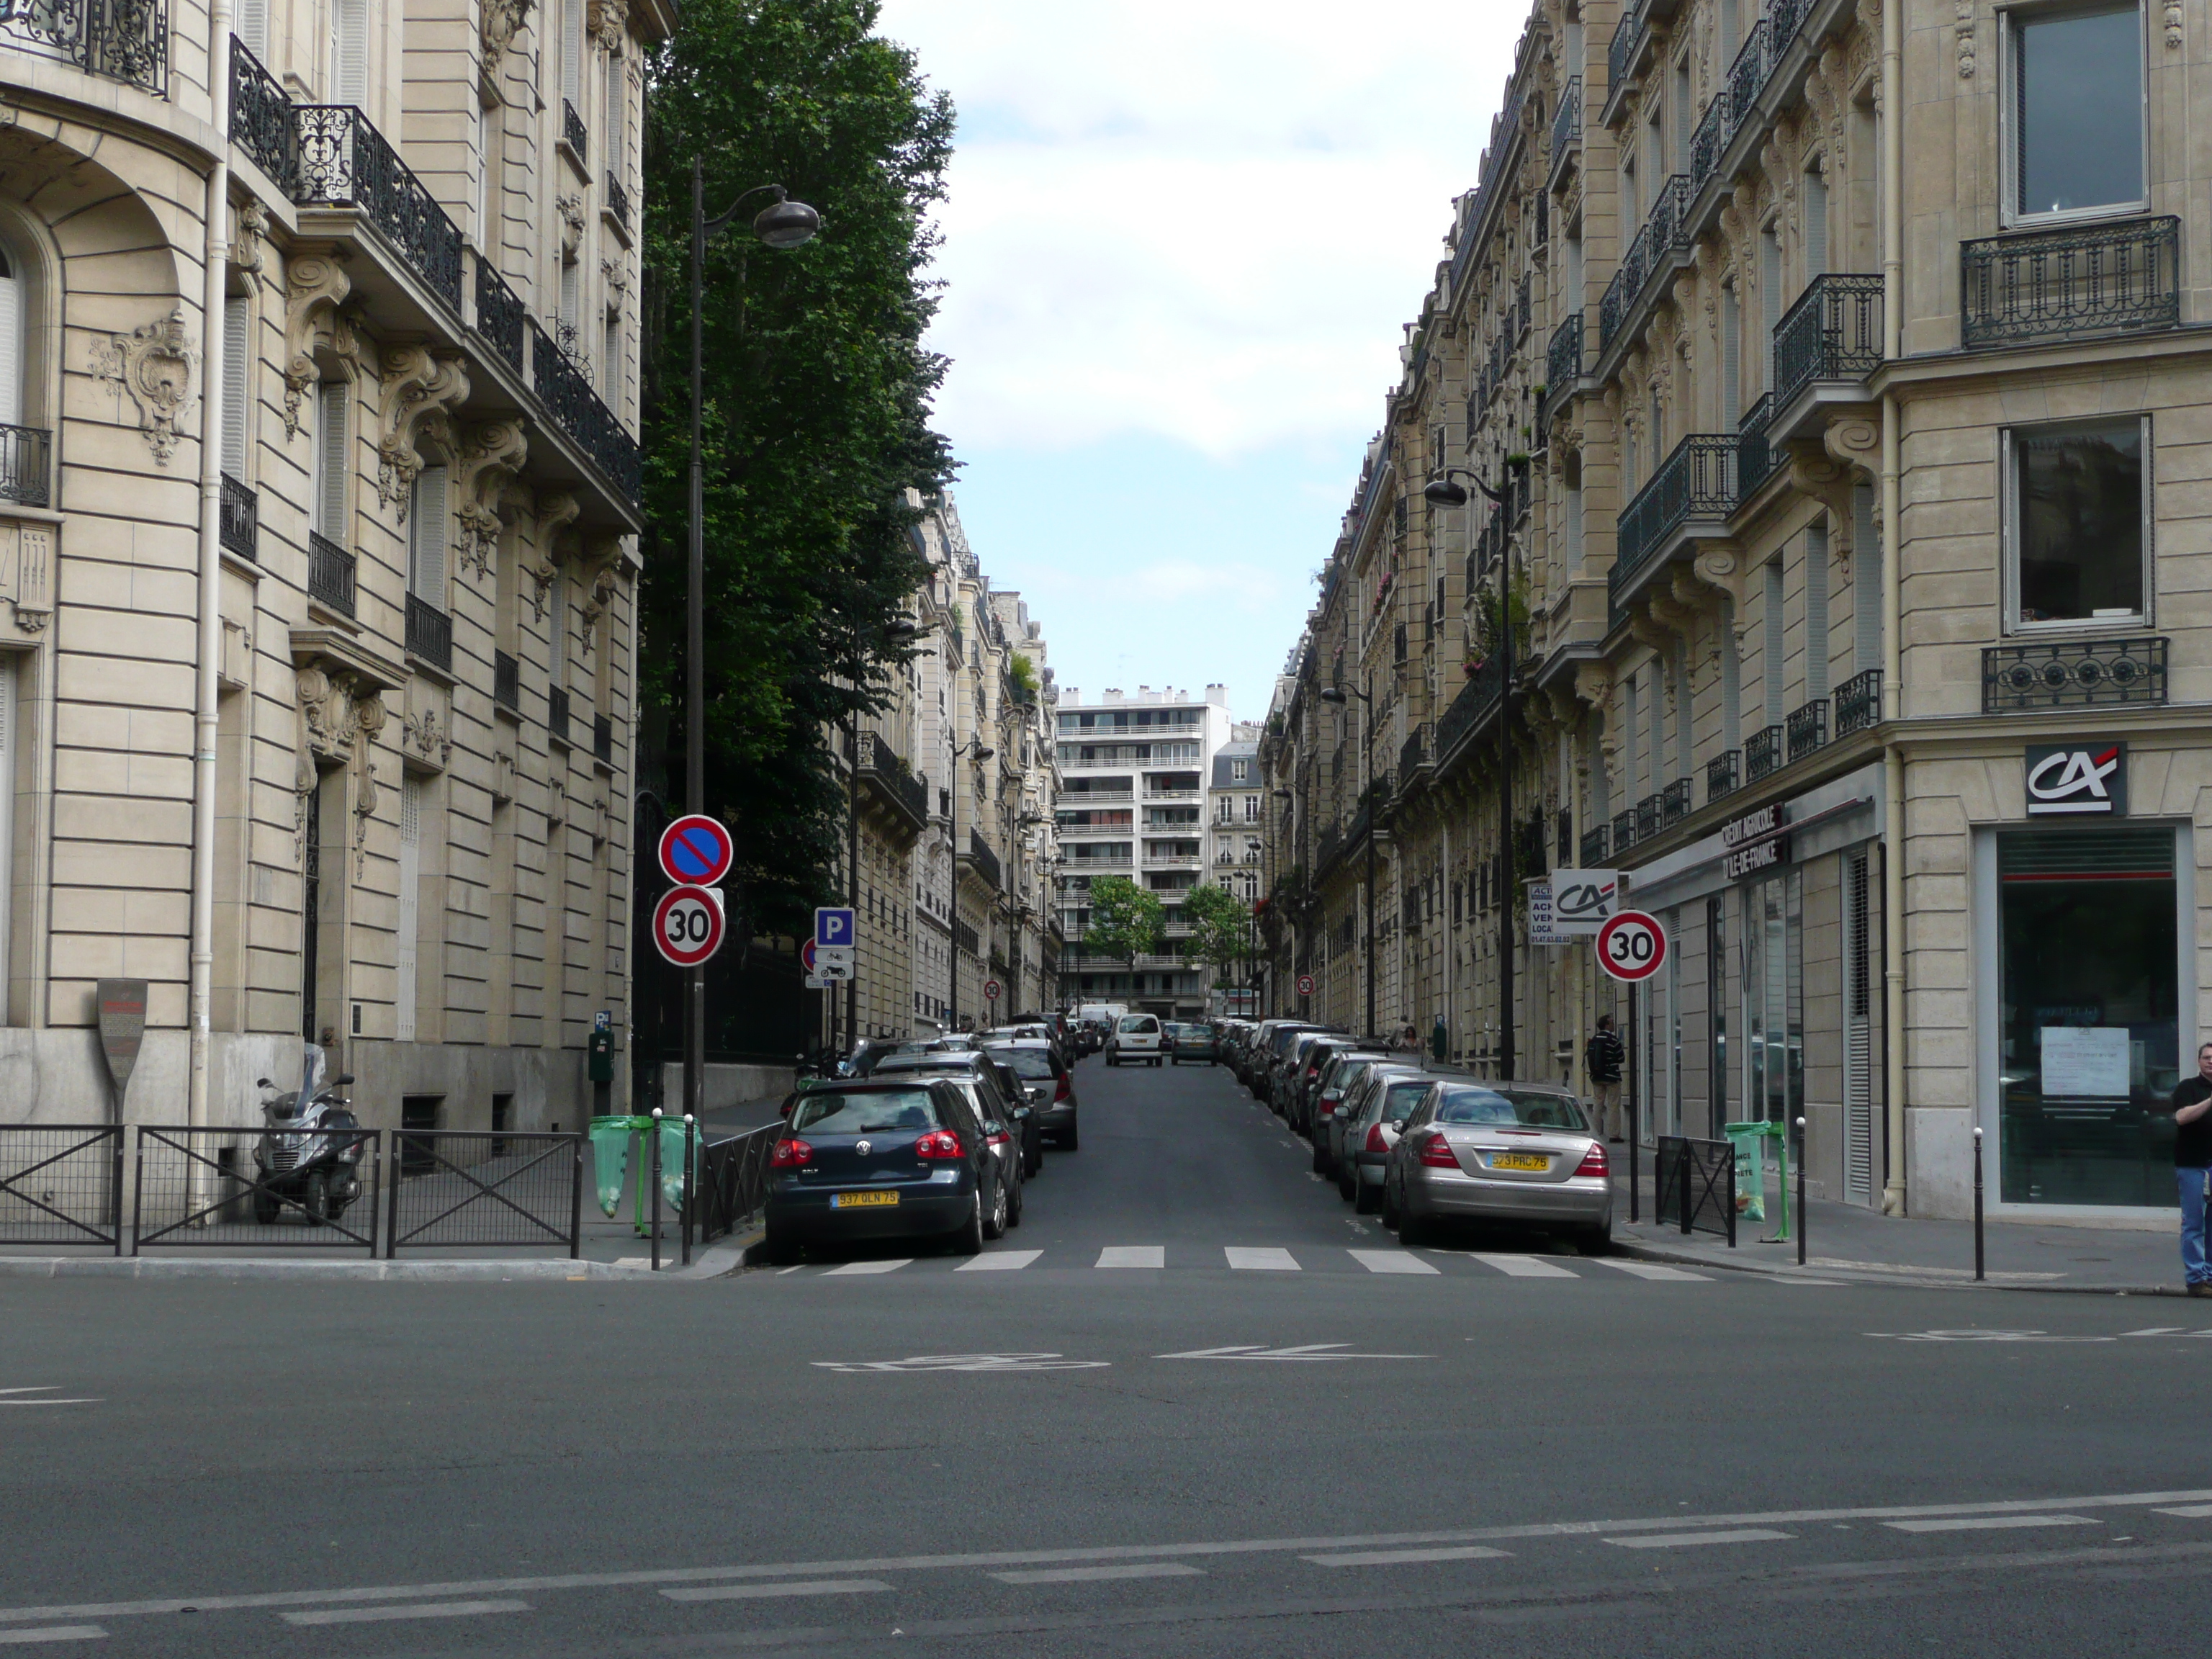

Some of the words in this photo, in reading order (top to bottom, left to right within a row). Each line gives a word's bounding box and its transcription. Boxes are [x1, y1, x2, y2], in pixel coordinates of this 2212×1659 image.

[1722, 819, 1743, 846] CRÉDIT
[1743, 805, 1776, 839] AGRICOLE
[667, 909, 709, 943] 30
[827, 916, 843, 940] P
[1611, 932, 1653, 961] 30
[987, 986, 997, 994] 30
[1300, 981, 1311, 990] 30
[1493, 1154, 1511, 1165] 573
[1513, 1156, 1532, 1166] PRC
[1534, 1157, 1547, 1167] 75
[840, 1194, 858, 1205] 937
[862, 1192, 881, 1203] QLN
[885, 1192, 896, 1202] 75
